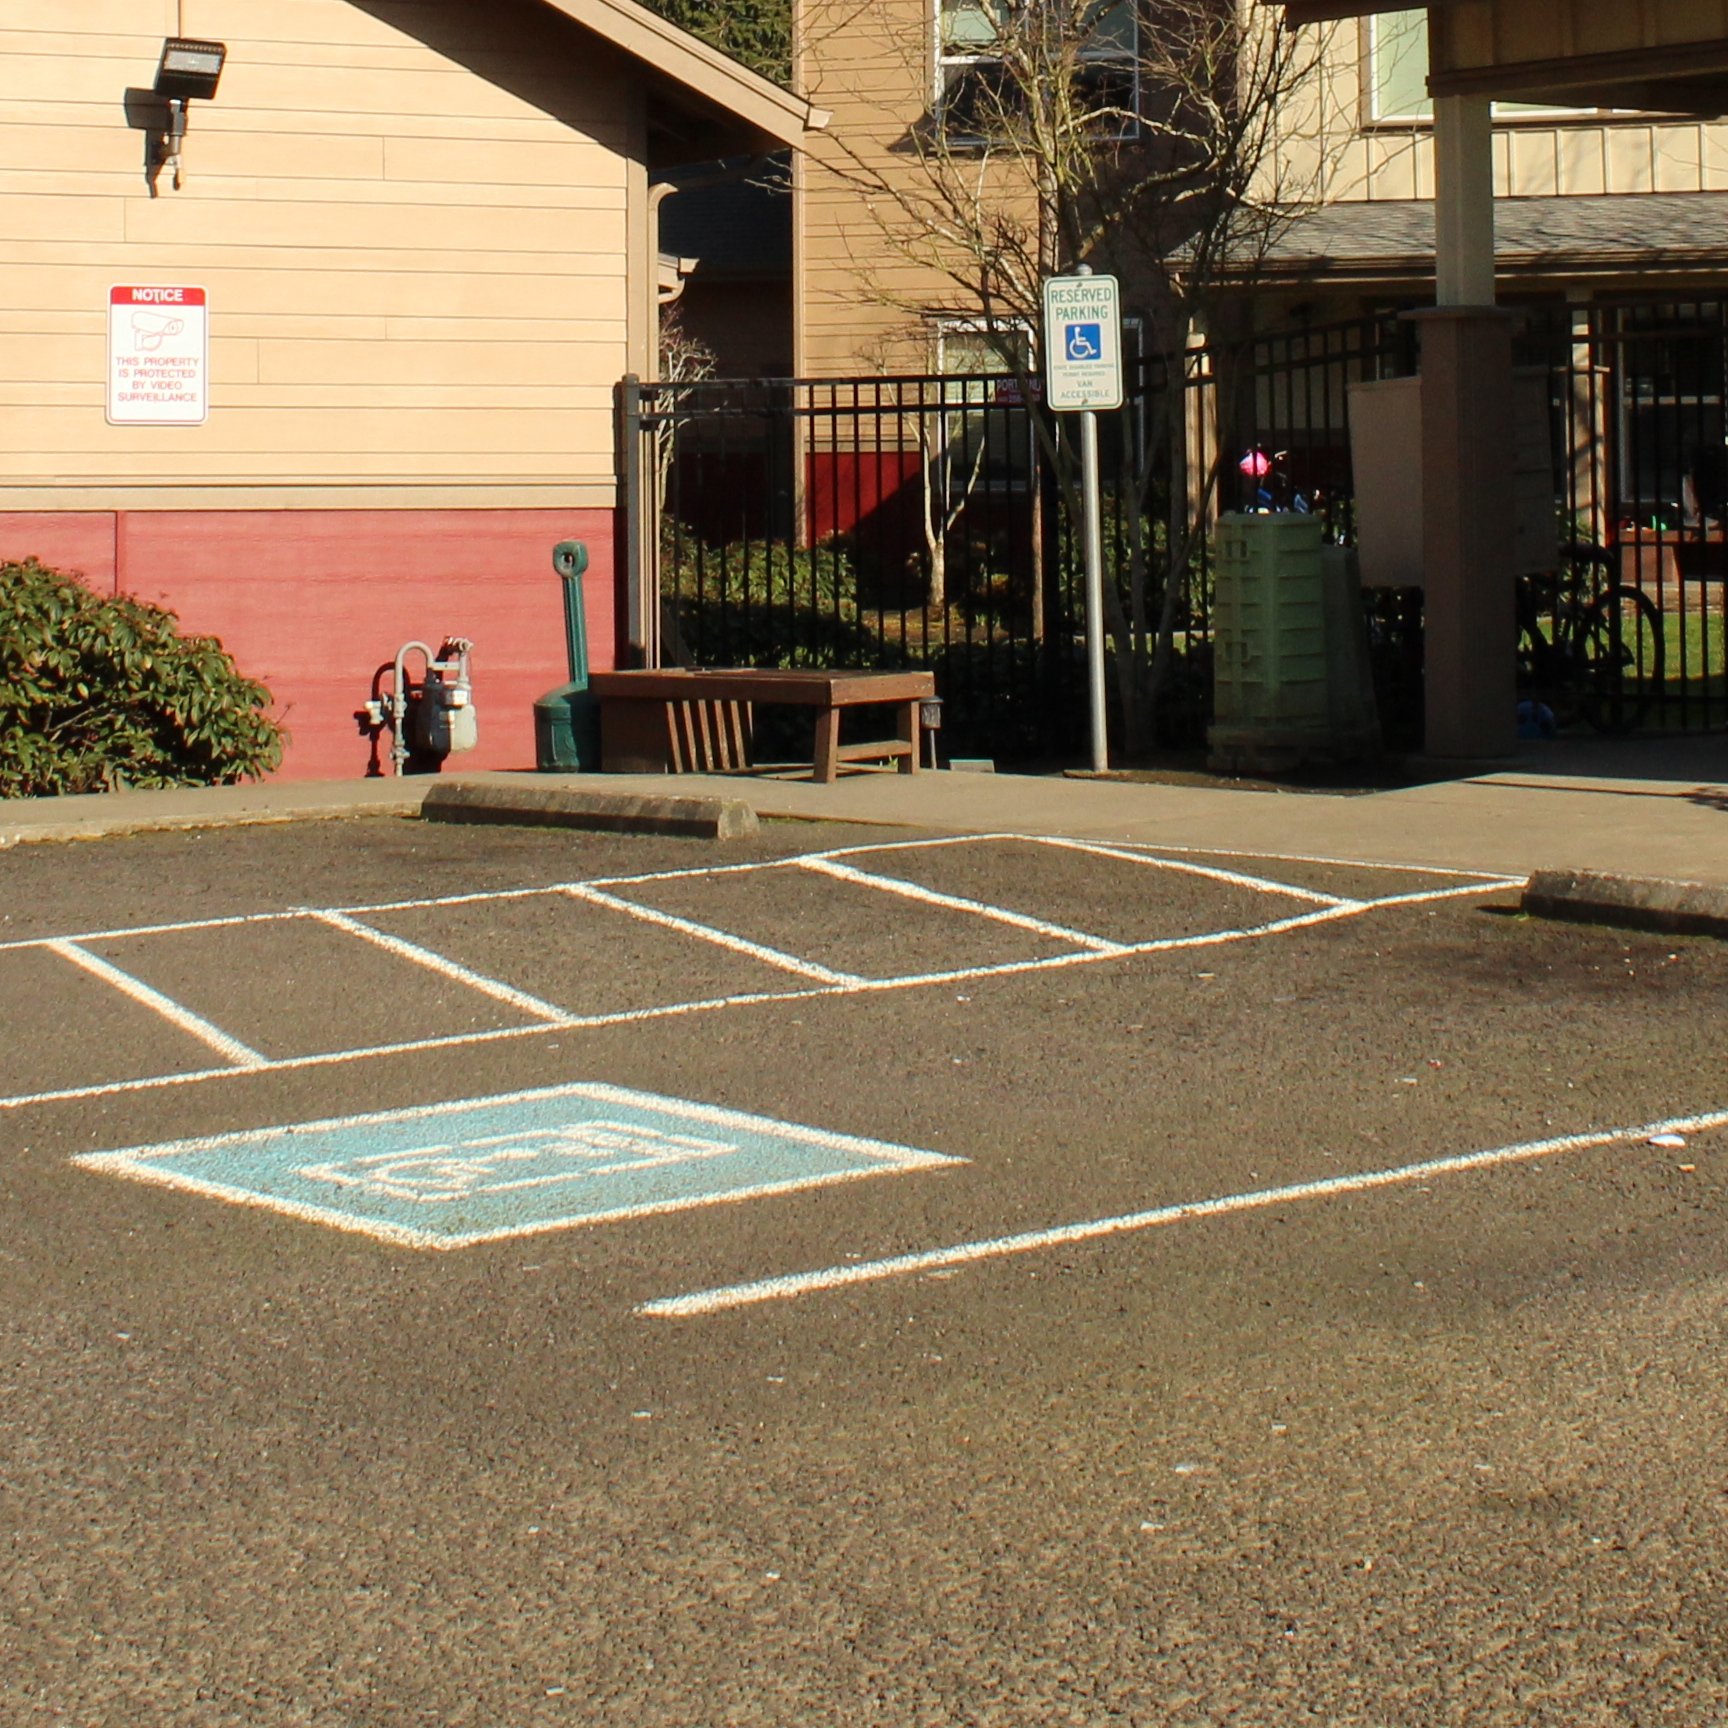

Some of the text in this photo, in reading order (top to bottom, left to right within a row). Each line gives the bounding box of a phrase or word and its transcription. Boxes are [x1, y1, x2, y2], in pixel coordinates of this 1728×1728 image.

[131, 288, 184, 303] NOTICE
[1051, 287, 1112, 304] RESERVED
[1055, 305, 1109, 321] PARKING
[115, 356, 200, 367] THIS PROPERTY
[117, 368, 197, 378] IS PROTECTED
[132, 380, 183, 390] BY VIDEO
[1077, 380, 1093, 388] VAN
[117, 391, 198, 402] SURVEILLANCE
[1060, 389, 1110, 398] ACCESSIBLE
